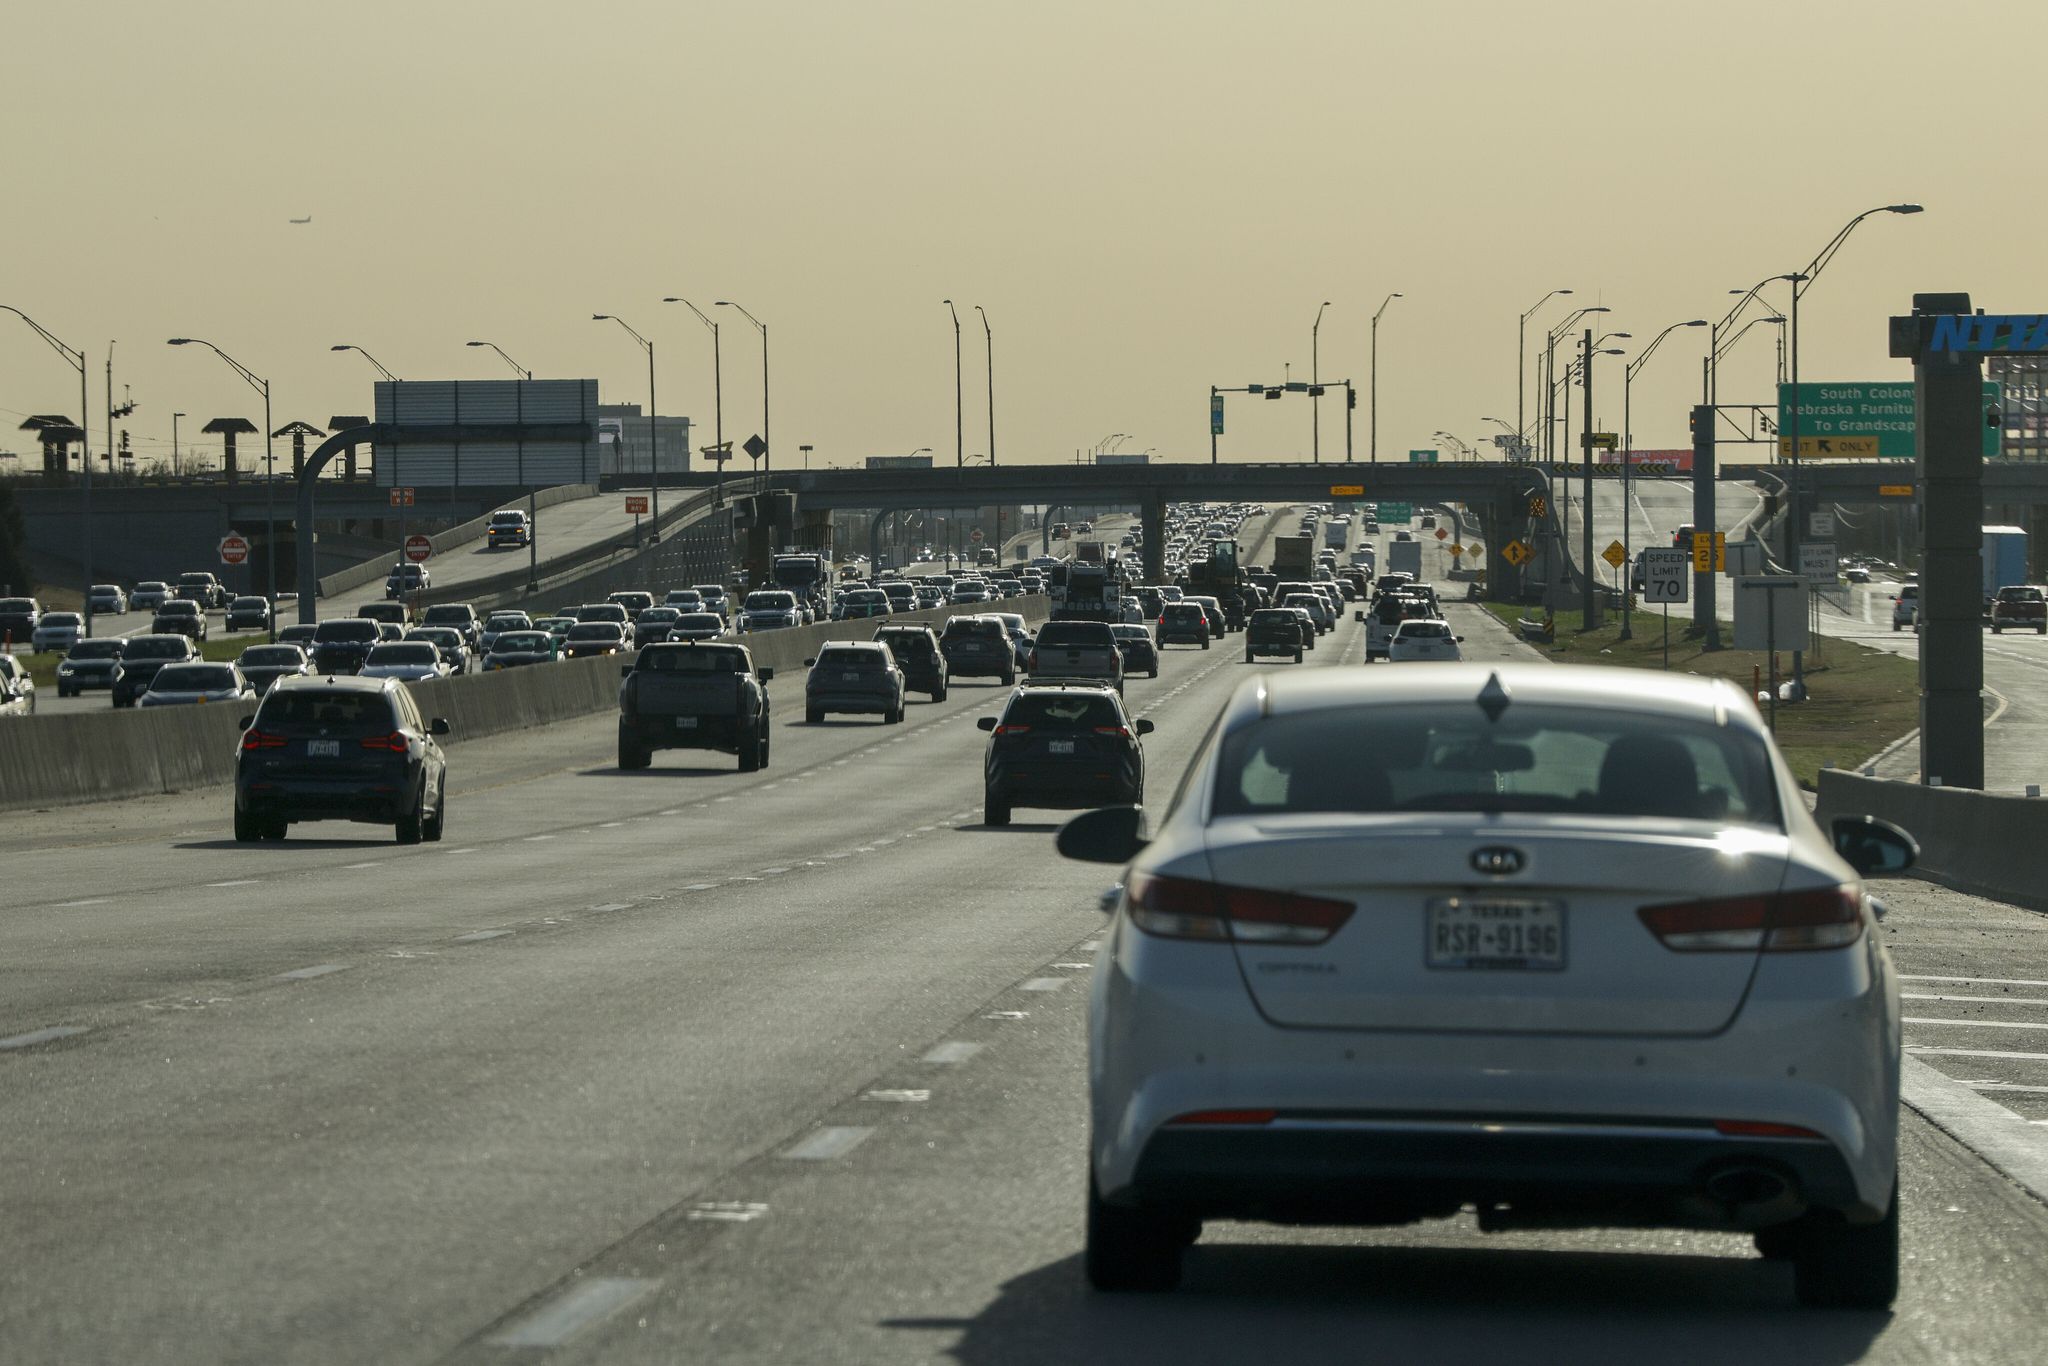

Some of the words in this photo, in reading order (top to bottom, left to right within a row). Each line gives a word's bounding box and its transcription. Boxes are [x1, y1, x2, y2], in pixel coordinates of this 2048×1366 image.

[1820, 388, 1861, 400] South
[1785, 403, 1854, 415] Nebraska
[1814, 420, 1832, 431] To
[1783, 442, 1810, 452] EIT
[1839, 442, 1873, 452] ONLY
[1649, 554, 1684, 563] SPEED
[1652, 567, 1680, 576] LIMIT
[1652, 580, 1680, 597] 70
[1476, 852, 1518, 869] KIA
